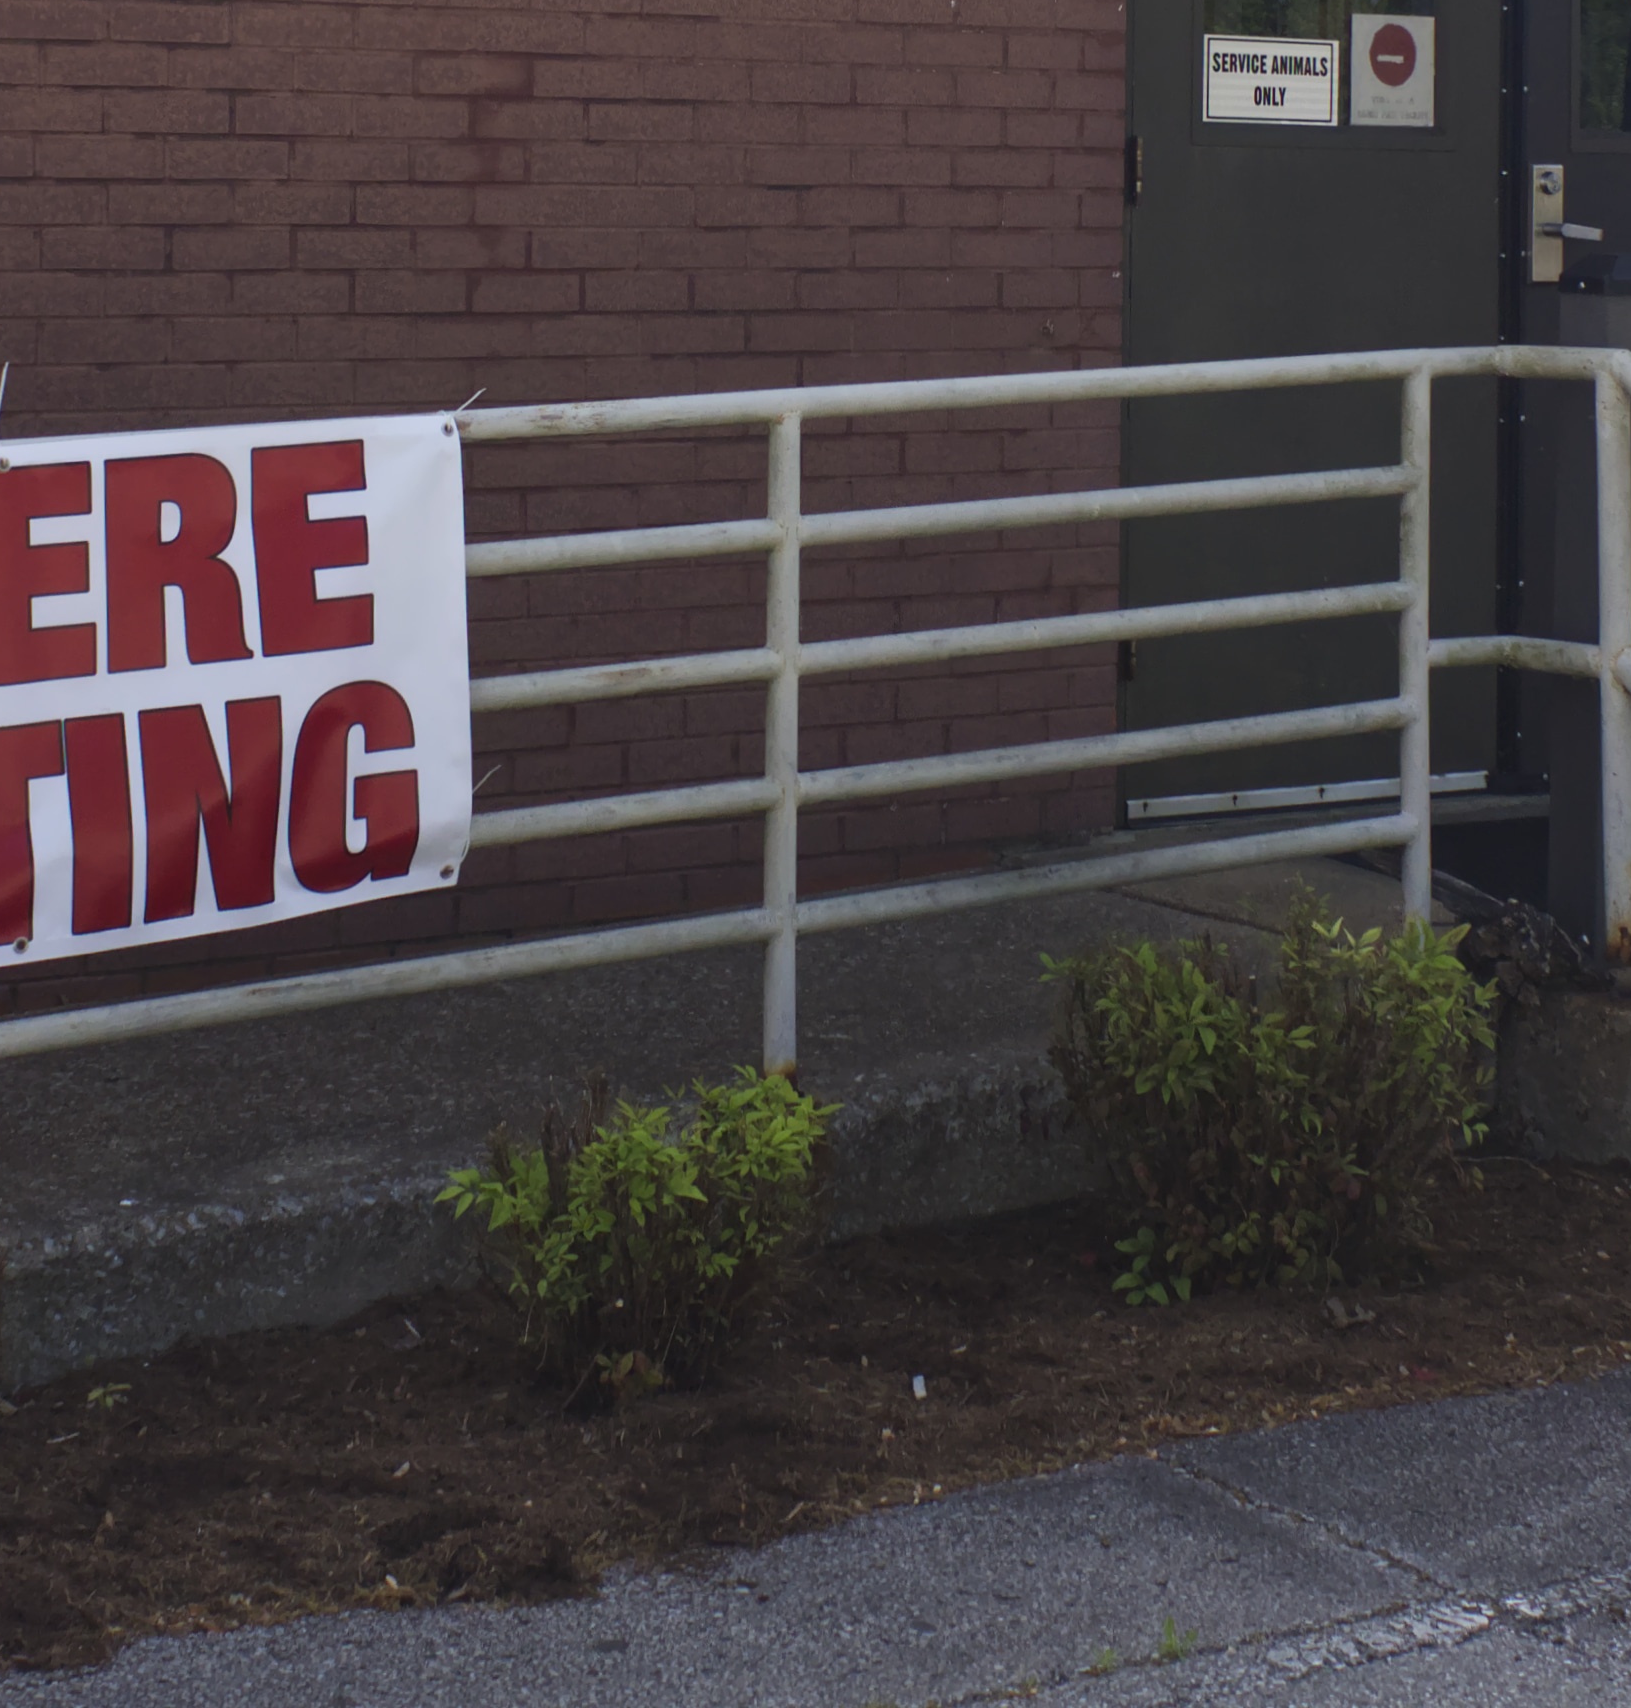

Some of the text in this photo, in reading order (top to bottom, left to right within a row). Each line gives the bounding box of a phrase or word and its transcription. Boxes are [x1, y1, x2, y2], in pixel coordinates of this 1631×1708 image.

[1212, 52, 1329, 77] SERVICE ANIMALS
[1253, 86, 1287, 107] ONLY
